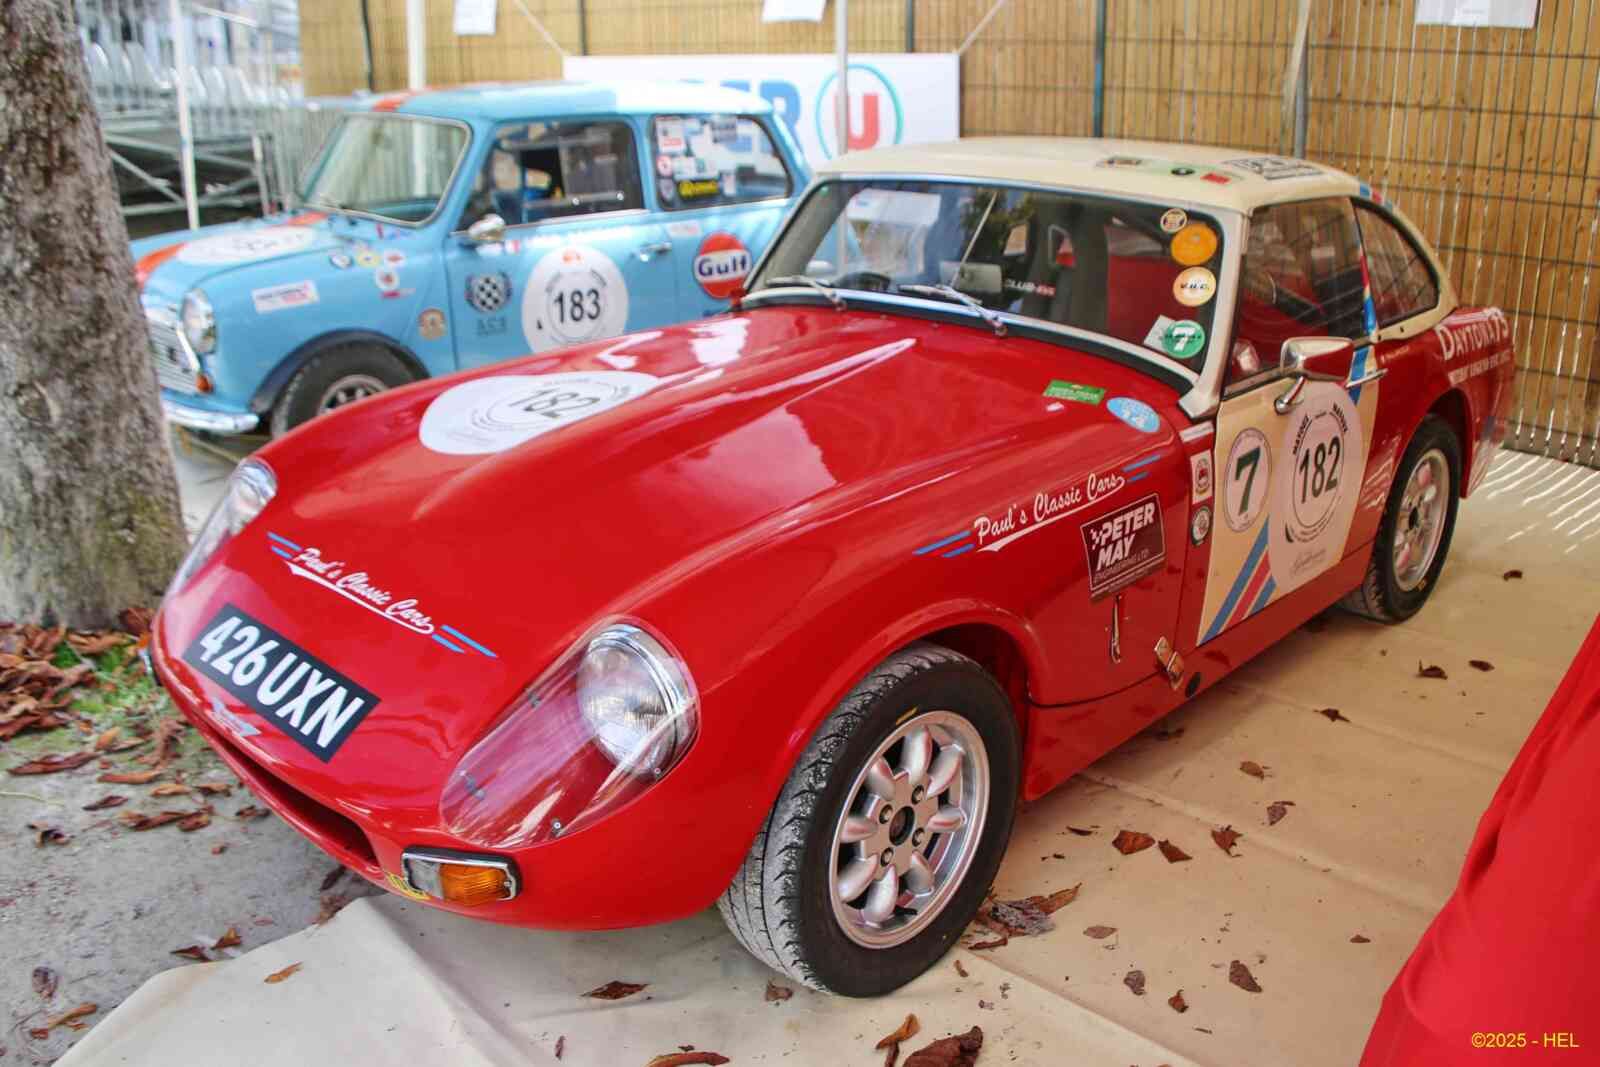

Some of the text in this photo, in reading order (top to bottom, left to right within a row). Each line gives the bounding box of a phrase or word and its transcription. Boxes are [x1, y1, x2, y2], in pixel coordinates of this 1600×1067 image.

[697, 255, 748, 278] Gulf
[553, 288, 601, 324] 183
[1172, 326, 1196, 352] 7
[508, 386, 600, 419] 182
[1235, 446, 1261, 516] 7
[1299, 436, 1341, 504] 182
[973, 472, 1118, 545] Paul's Classic Cars
[1100, 501, 1157, 546] PETER
[1096, 534, 1136, 571] MAY
[295, 547, 432, 627] Paul's Classic Cars
[199, 615, 280, 686] 426
[256, 651, 365, 749] UXN
